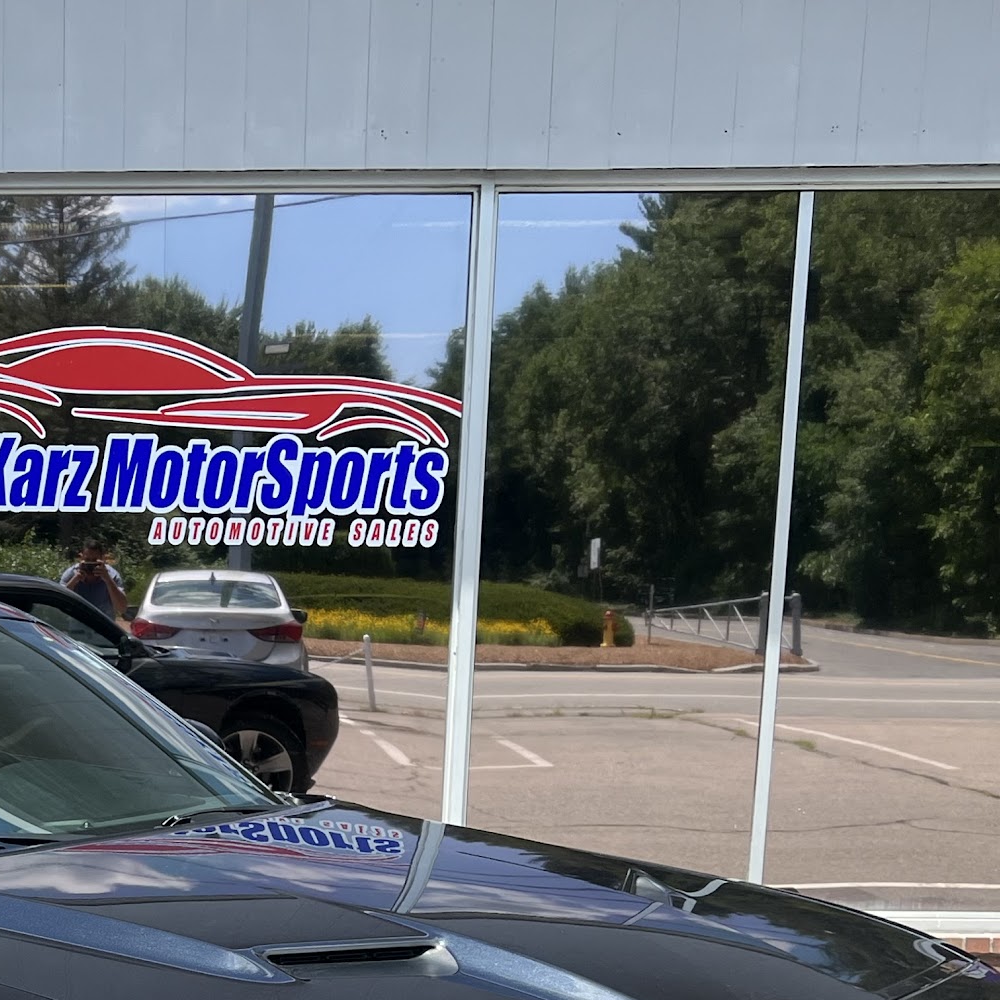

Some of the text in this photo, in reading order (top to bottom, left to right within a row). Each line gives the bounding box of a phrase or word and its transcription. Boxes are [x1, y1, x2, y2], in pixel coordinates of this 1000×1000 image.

[97, 433, 449, 520] MotorSports
[150, 518, 438, 547] AUTOMOTIVE SALES
